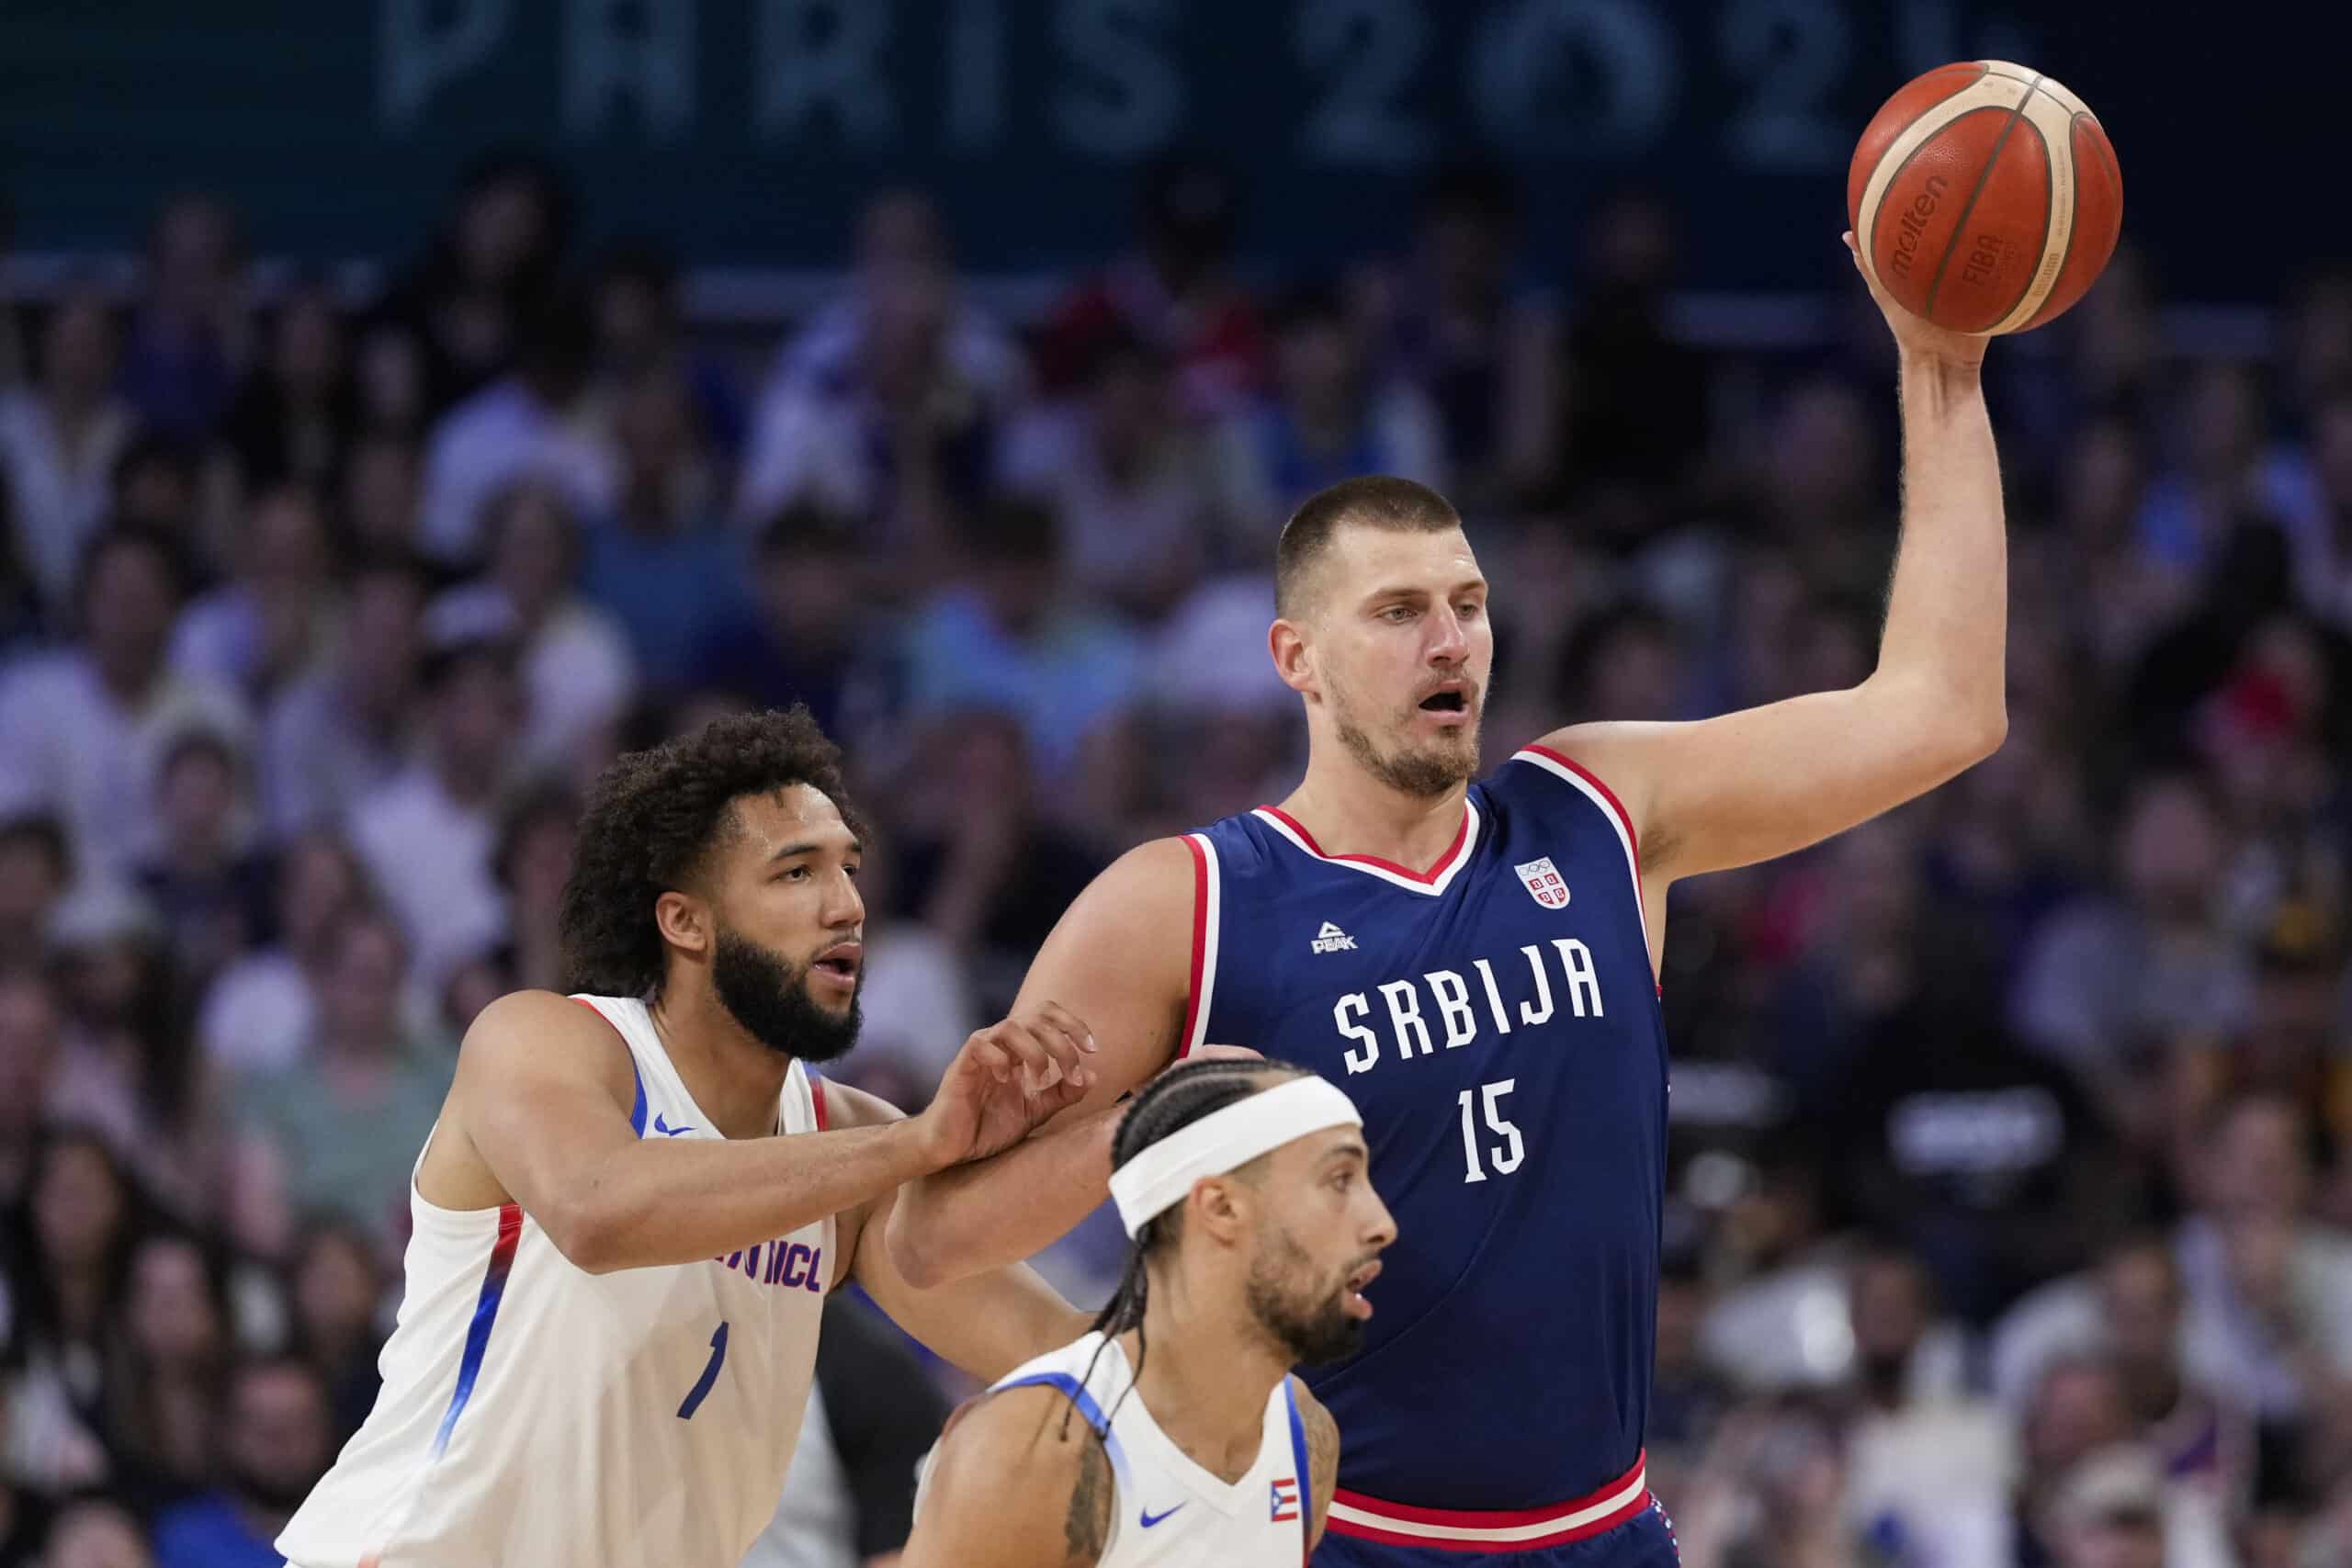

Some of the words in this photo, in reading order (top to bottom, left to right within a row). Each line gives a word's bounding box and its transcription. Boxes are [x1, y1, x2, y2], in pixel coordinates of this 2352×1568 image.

[375, 0, 1187, 154] PARIS
[1891, 175, 1949, 279] molten
[1962, 234, 2004, 288] FIBA
[1311, 936, 1359, 955] PEAK
[1333, 938, 1604, 1076] SRBIJA
[1457, 1078, 1525, 1184] 15
[675, 1320, 729, 1421] 1
